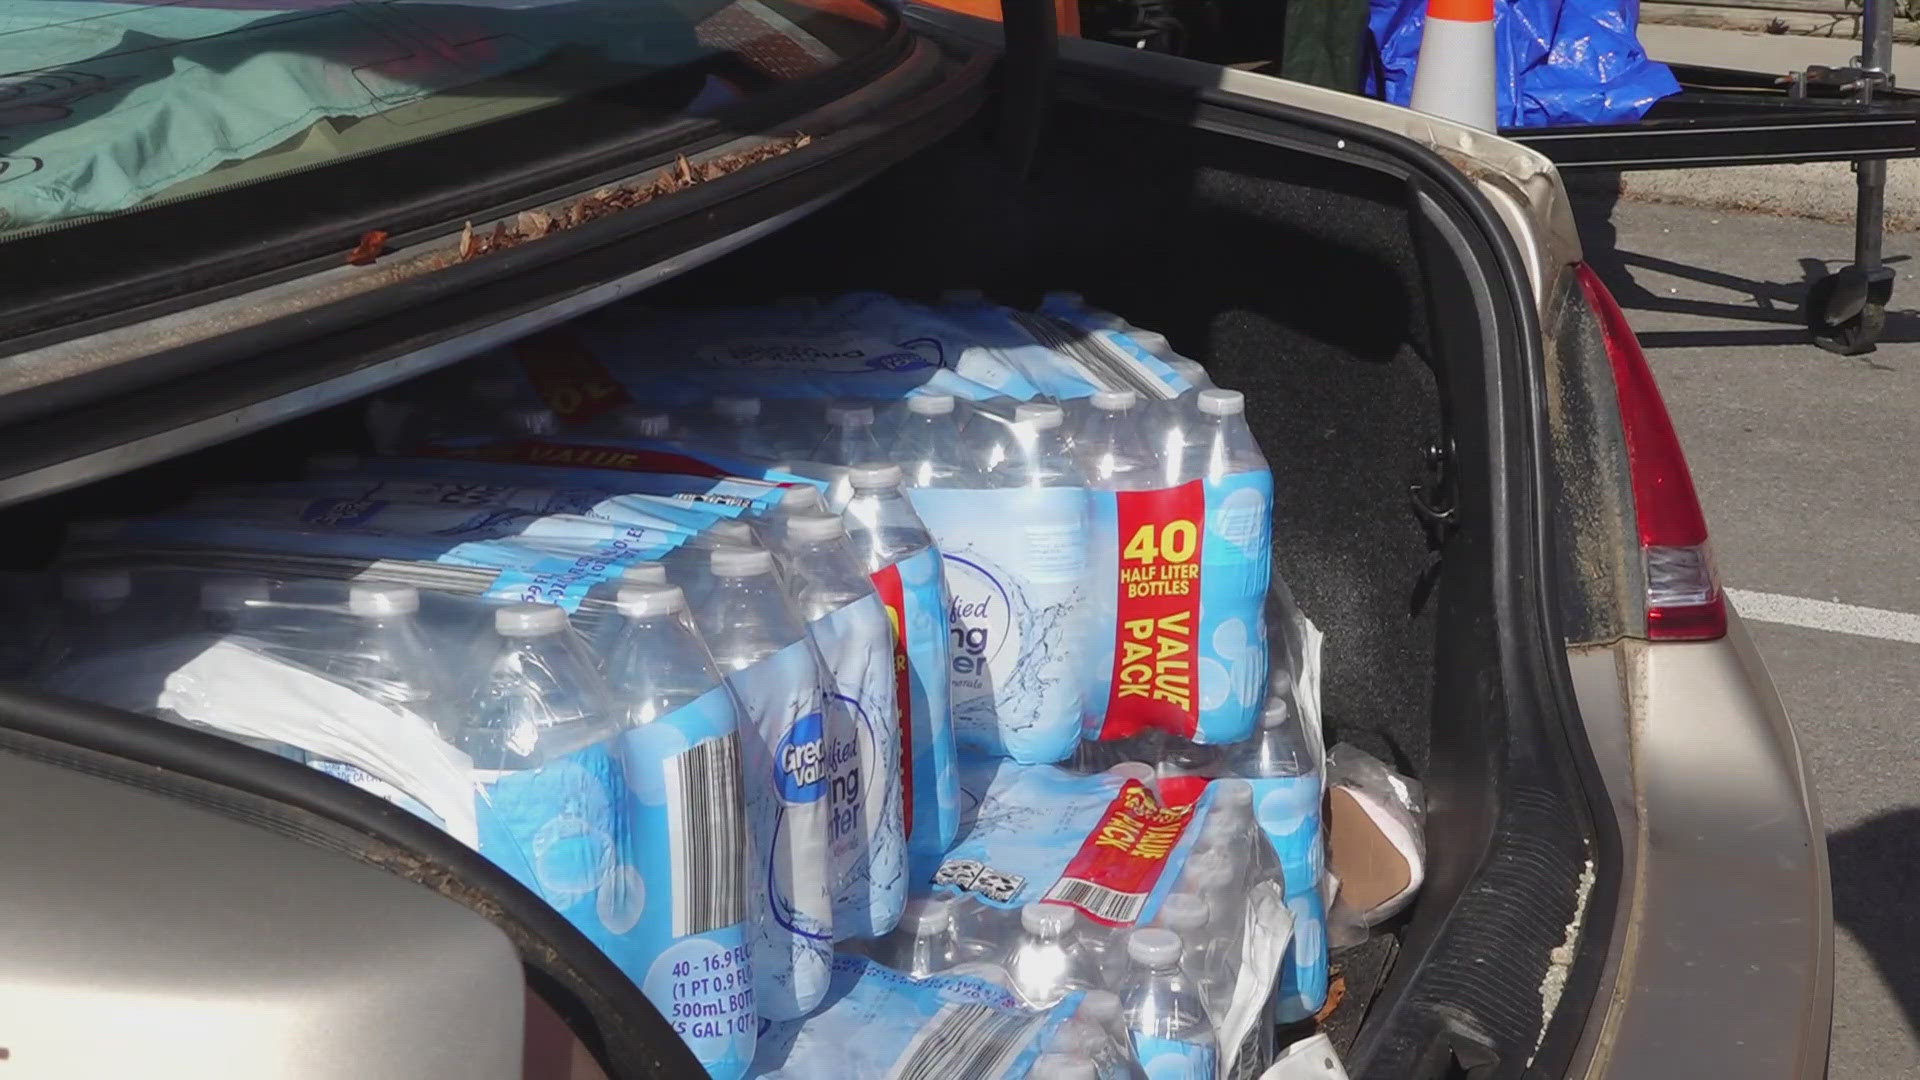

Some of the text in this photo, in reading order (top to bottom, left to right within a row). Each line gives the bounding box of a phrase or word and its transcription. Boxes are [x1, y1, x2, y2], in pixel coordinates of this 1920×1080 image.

[1123, 520, 1198, 564] 40
[1121, 564, 1199, 584] HALF LITER
[1128, 580, 1190, 598] BOTTLES
[949, 595, 991, 624] fied
[951, 627, 988, 655] ng
[1118, 618, 1155, 698] PACK
[1152, 611, 1191, 712] VALUE
[781, 738, 826, 774] Grea
[1095, 811, 1145, 852] PACK
[1130, 823, 1182, 859] VALUE
[672, 961, 690, 978] 40
[703, 951, 732, 972] 16.9
[734, 946, 745, 964] FL
[673, 983, 686, 1001] (1
[691, 979, 709, 996] PT
[713, 973, 734, 993] 0.9
[737, 967, 747, 987] FL
[672, 988, 755, 1018] 500mL BOTT
[692, 1021, 723, 1039] GAL
[727, 1019, 733, 1034] 1
[737, 1012, 751, 1034] QT
